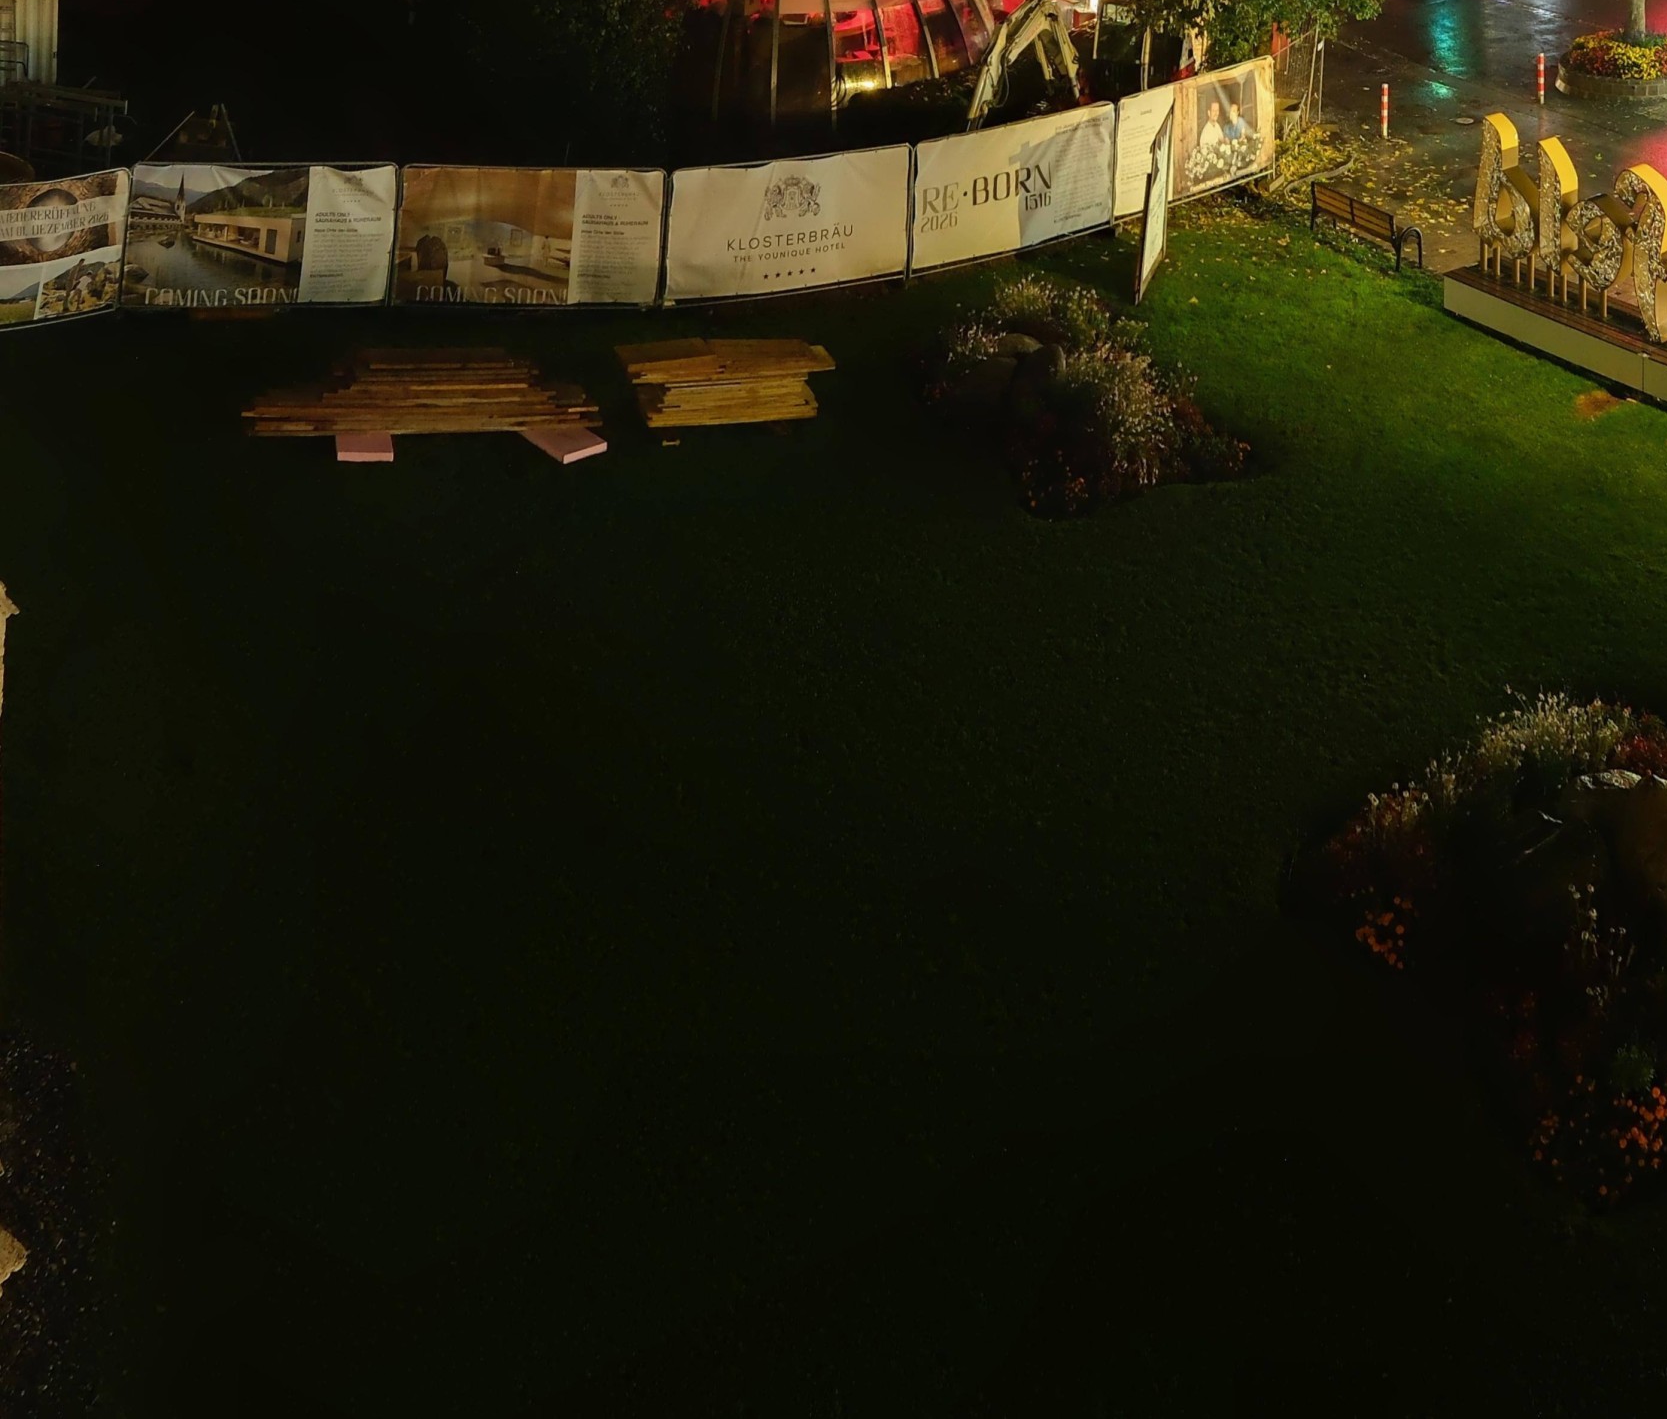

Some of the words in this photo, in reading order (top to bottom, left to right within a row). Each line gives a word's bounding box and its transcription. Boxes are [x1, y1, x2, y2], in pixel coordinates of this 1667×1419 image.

[1025, 191, 1052, 211] 1516
[921, 212, 958, 233] 2026
[727, 222, 854, 252] KLOSTERBRÄU
[734, 255, 752, 263] THE
[758, 247, 811, 261] YOUNIQUE
[815, 242, 846, 254] HOTEL
[145, 287, 227, 307] COMING
[415, 284, 497, 304] COMING
